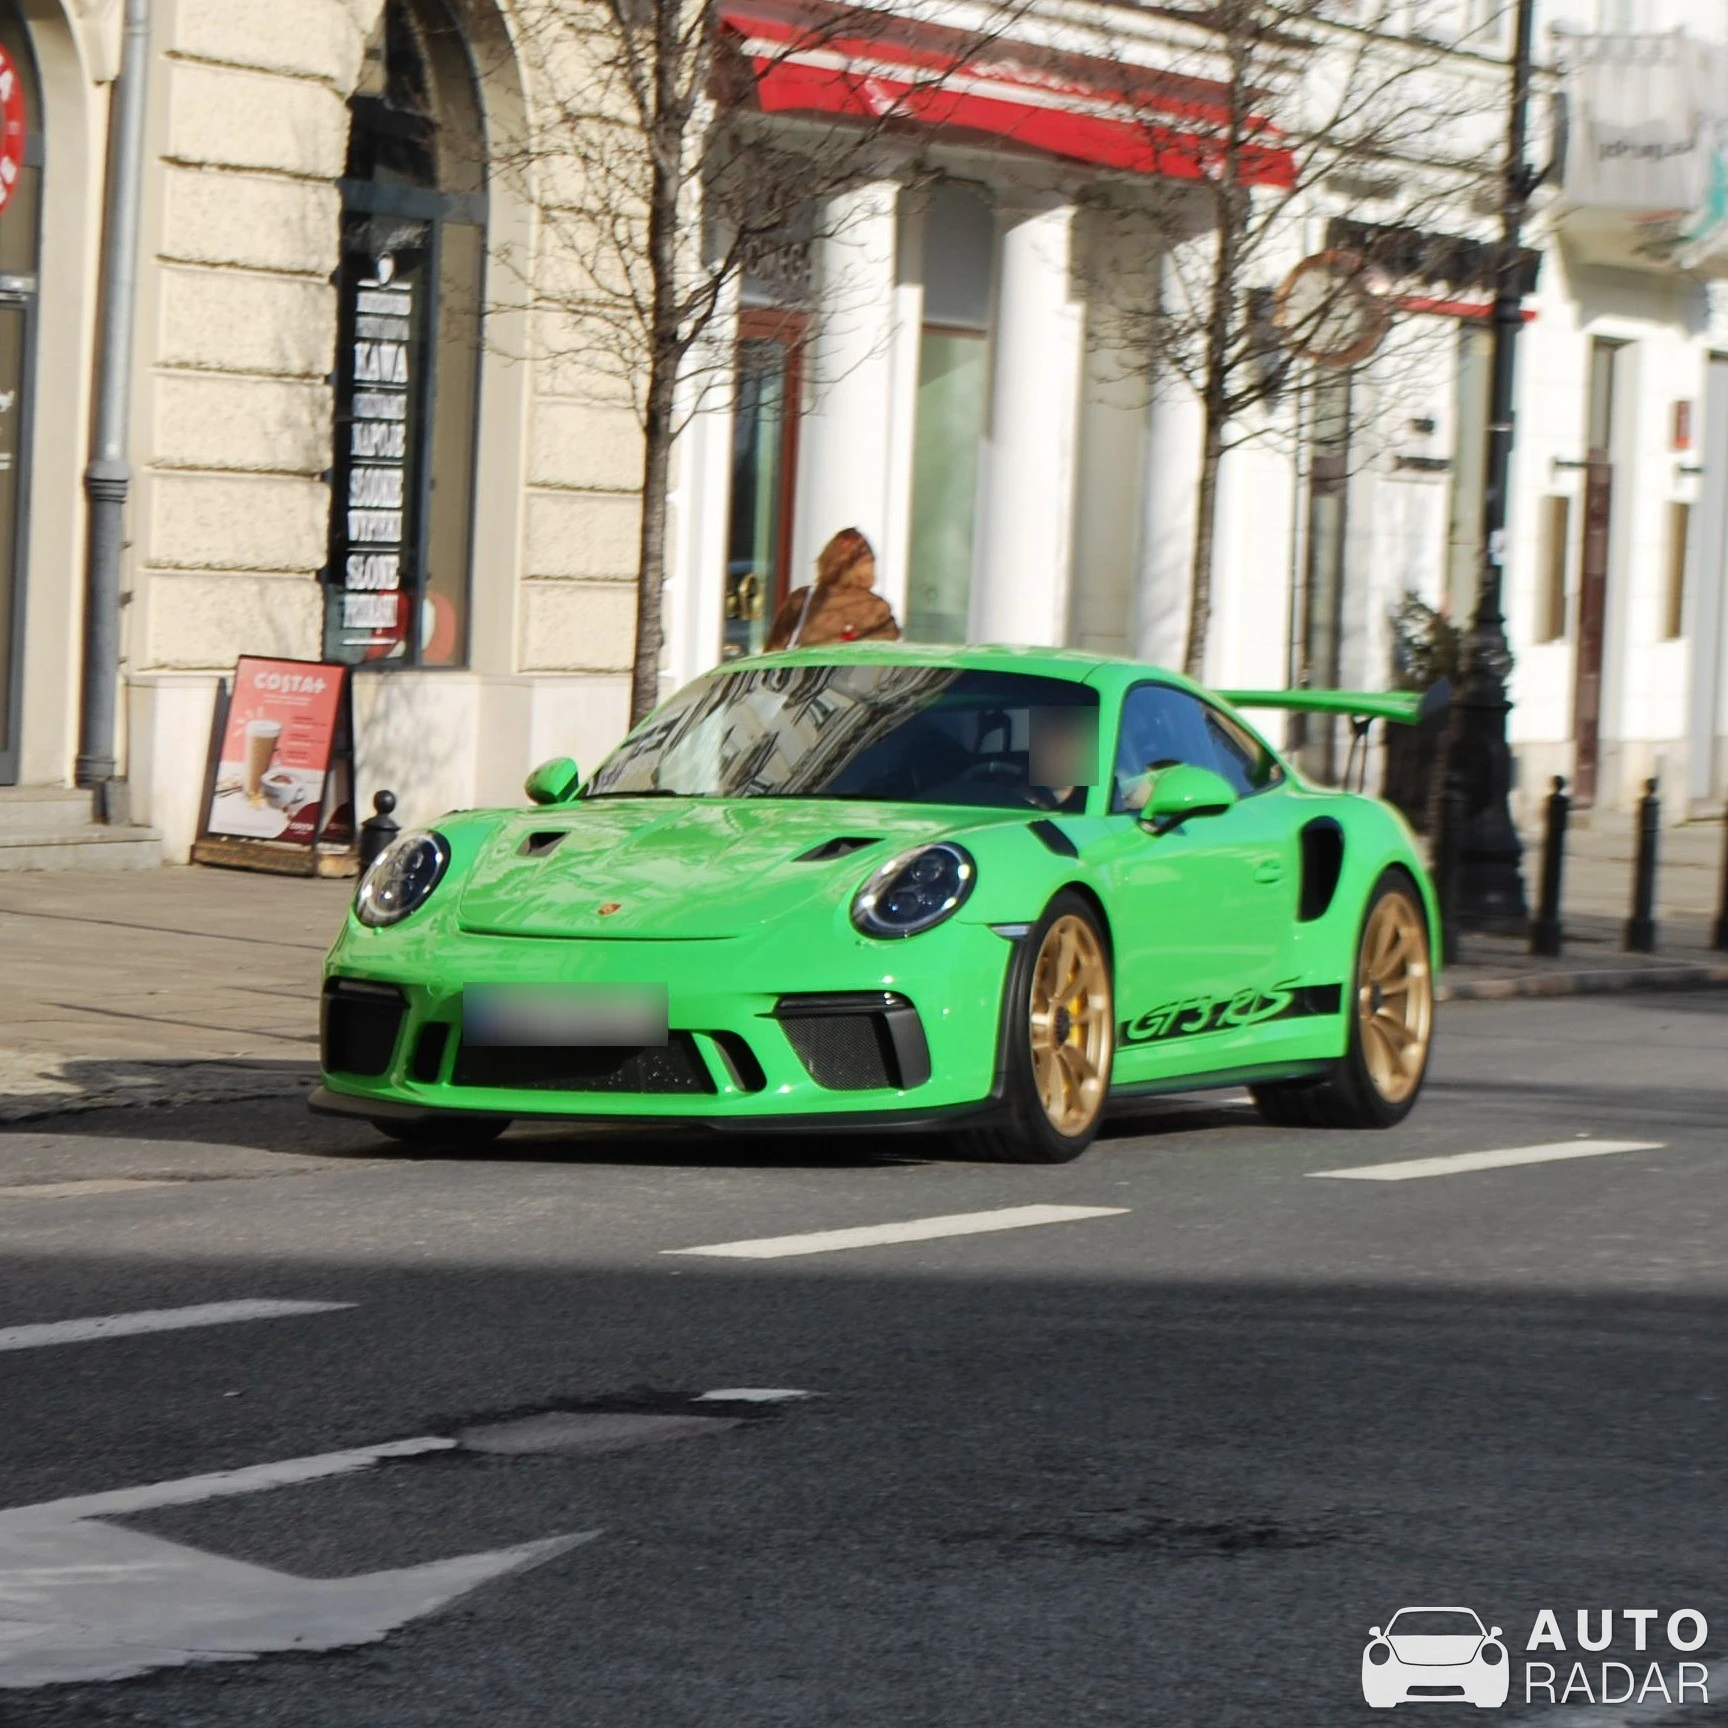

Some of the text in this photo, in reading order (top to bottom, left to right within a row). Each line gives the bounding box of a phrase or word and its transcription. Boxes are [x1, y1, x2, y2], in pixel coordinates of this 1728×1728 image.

[355, 343, 408, 382] KAWA
[1126, 975, 1302, 1040] GT3 RS
